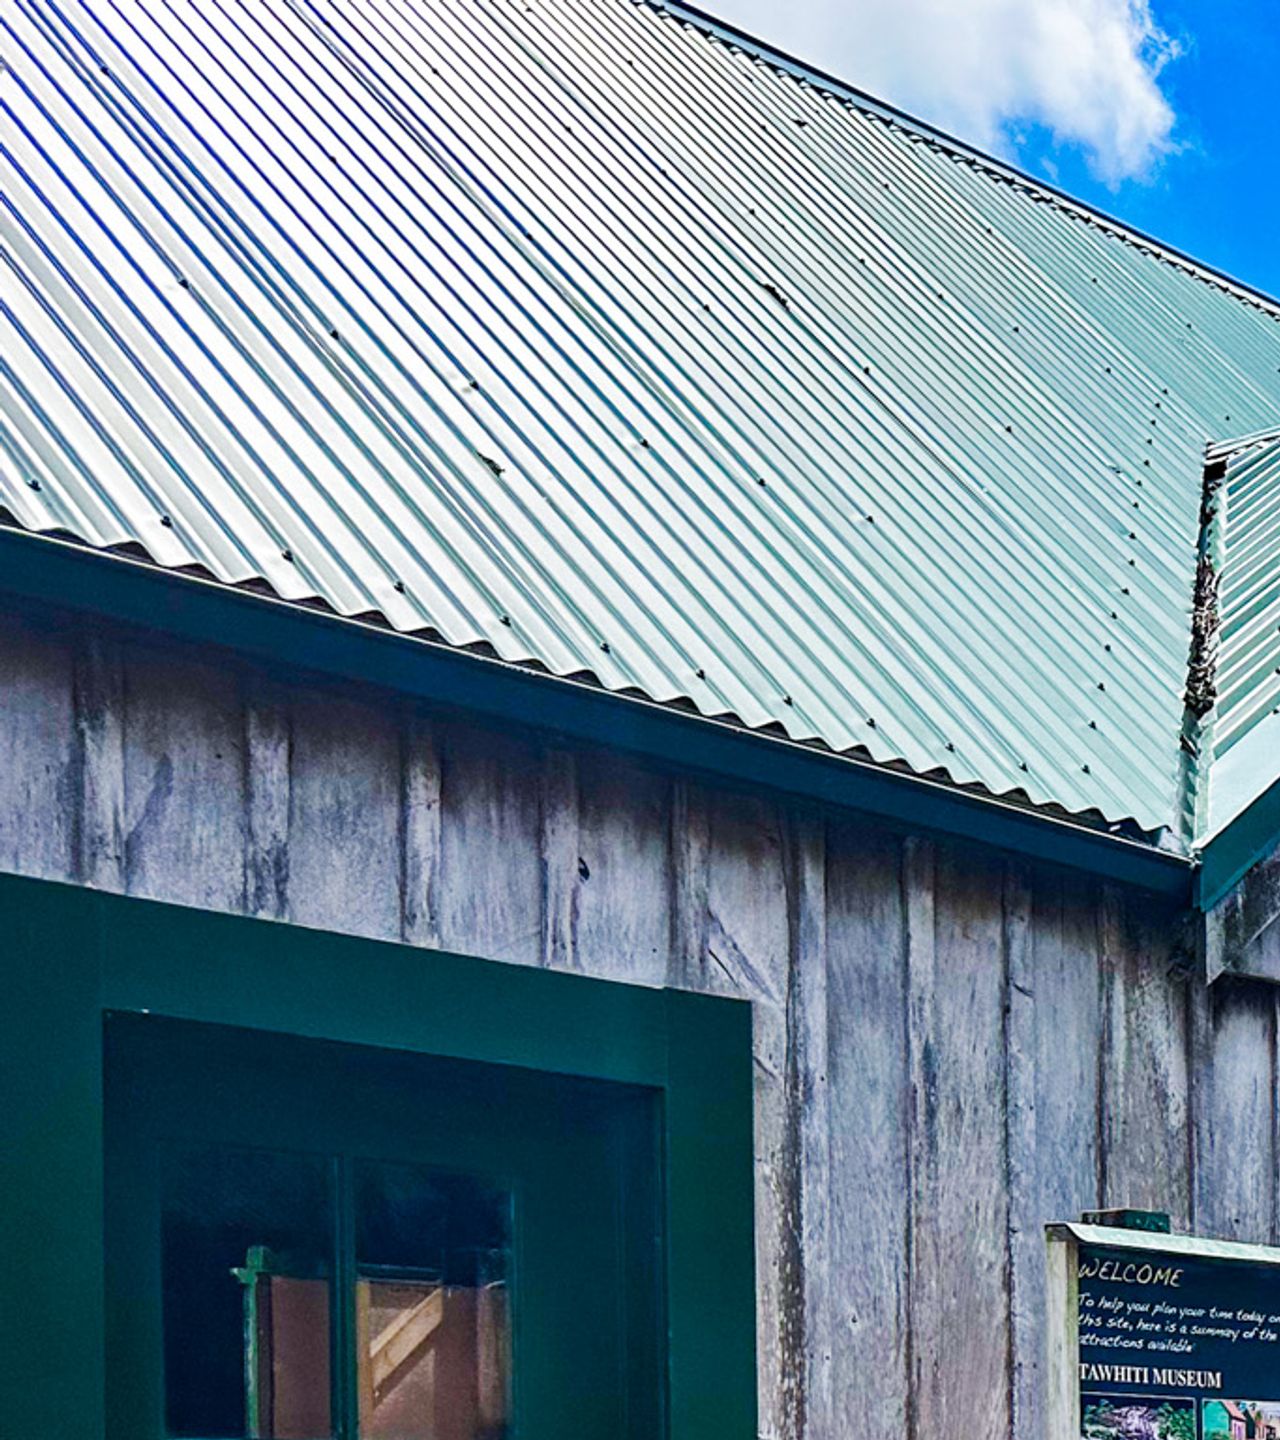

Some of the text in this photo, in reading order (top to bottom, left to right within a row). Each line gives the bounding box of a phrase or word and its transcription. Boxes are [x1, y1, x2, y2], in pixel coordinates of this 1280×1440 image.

[1078, 1258, 1184, 1288] WELCOME
[1078, 1292, 1095, 1307] To
[1098, 1296, 1125, 1313] help
[1127, 1302, 1151, 1315] you
[1152, 1301, 1177, 1317] plan
[1179, 1308, 1206, 1320] your
[1209, 1306, 1234, 1319] time
[1236, 1309, 1266, 1326] today
[1106, 1317, 1133, 1332] site,
[1136, 1318, 1161, 1332] here
[1164, 1320, 1177, 1333] is
[1179, 1324, 1188, 1335] a
[1242, 1327, 1259, 1339] of
[1259, 1329, 1278, 1341] the
[1079, 1363, 1222, 1389] TAWHITI MUSEUM
